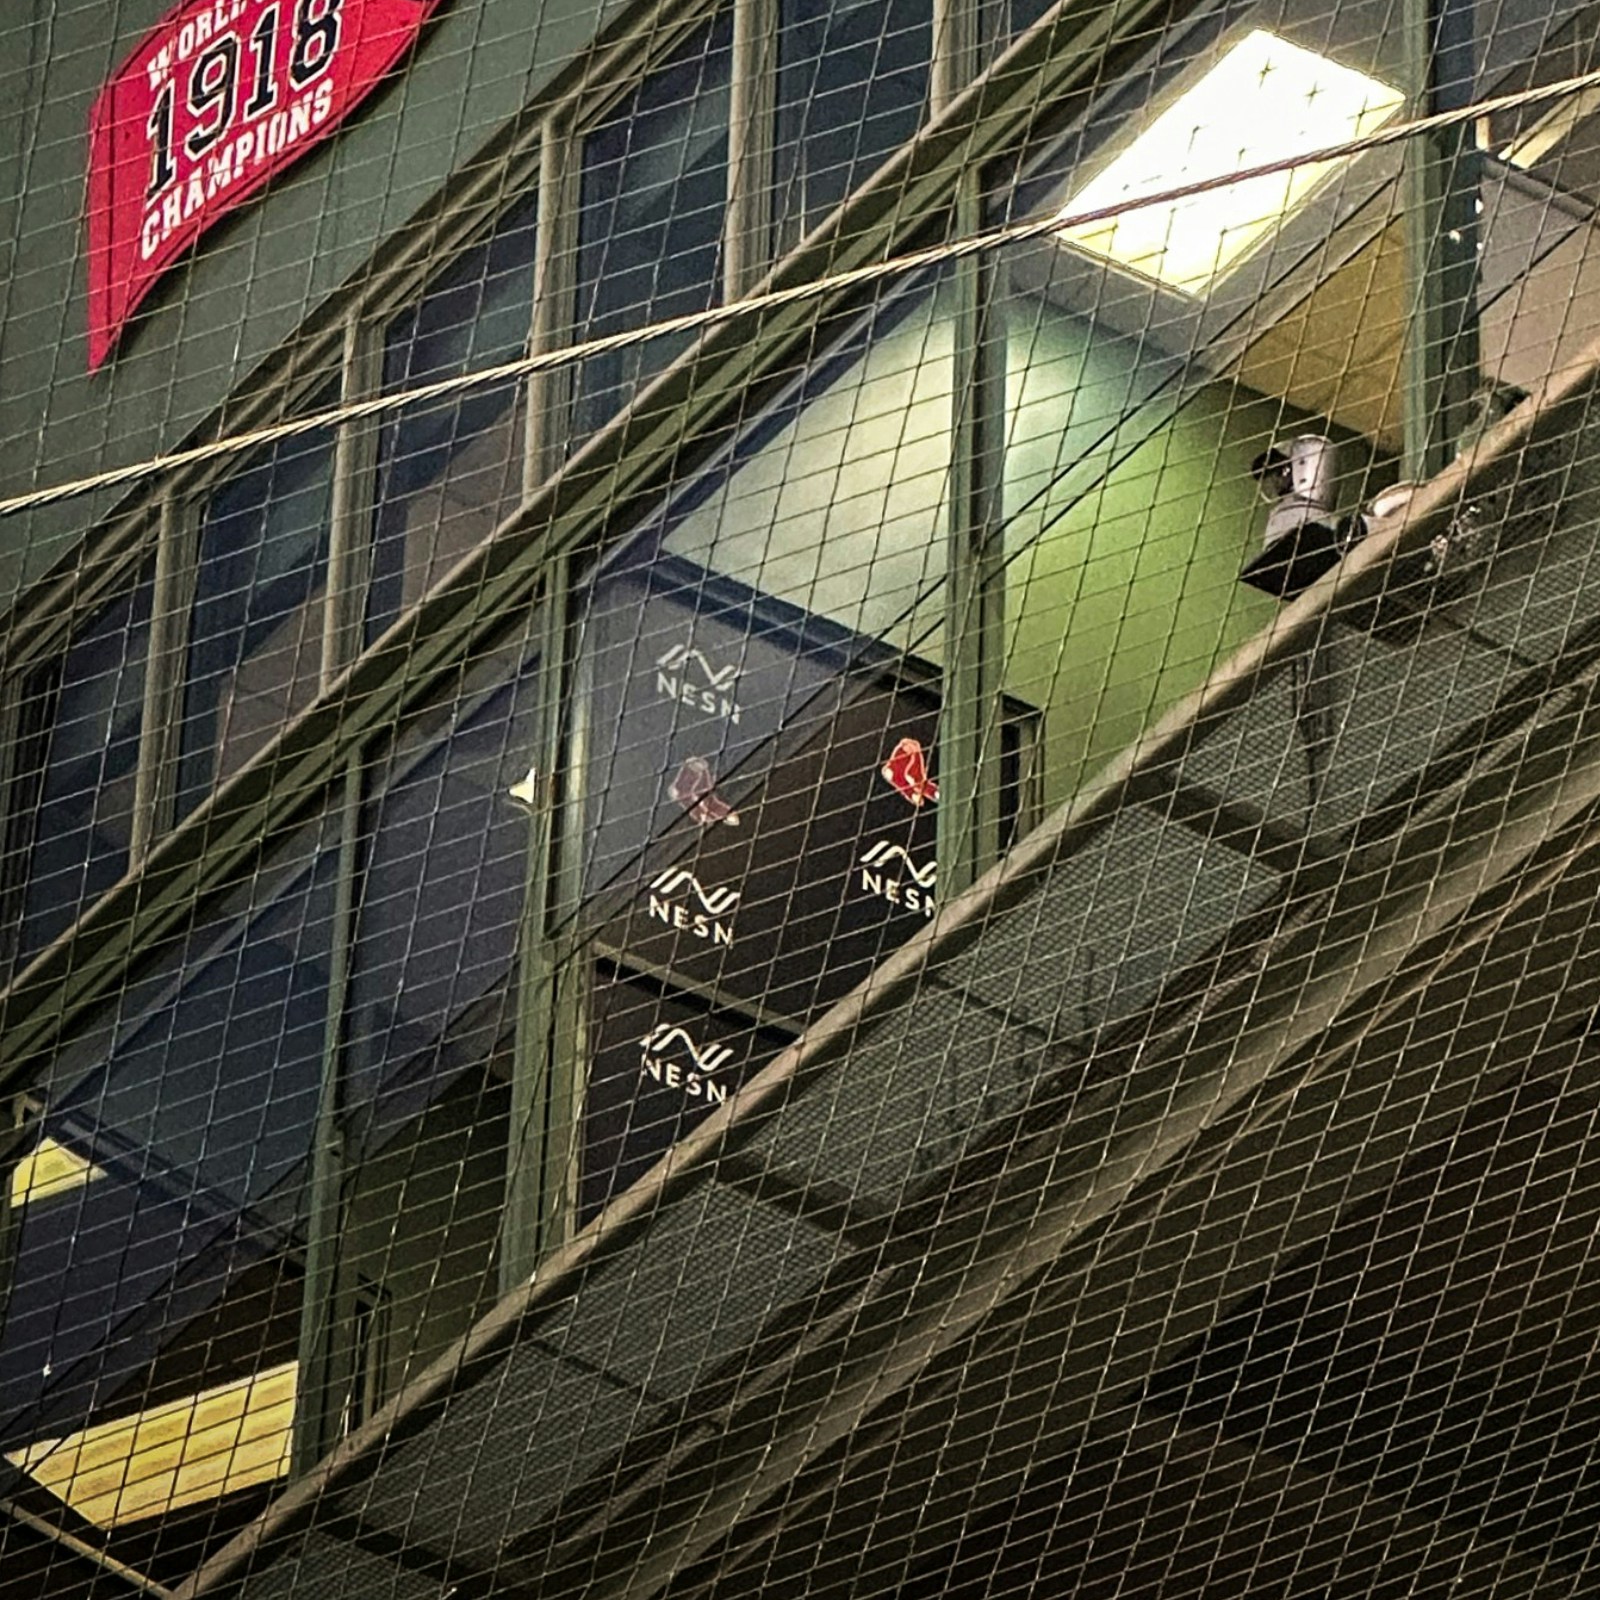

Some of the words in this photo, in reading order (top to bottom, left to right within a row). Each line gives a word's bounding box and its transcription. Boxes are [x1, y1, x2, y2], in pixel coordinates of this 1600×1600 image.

[141, 79, 333, 262] CHAMPIONS
[658, 674, 740, 725] NESN
[651, 898, 734, 946] NESN
[643, 1057, 727, 1104] NESN
